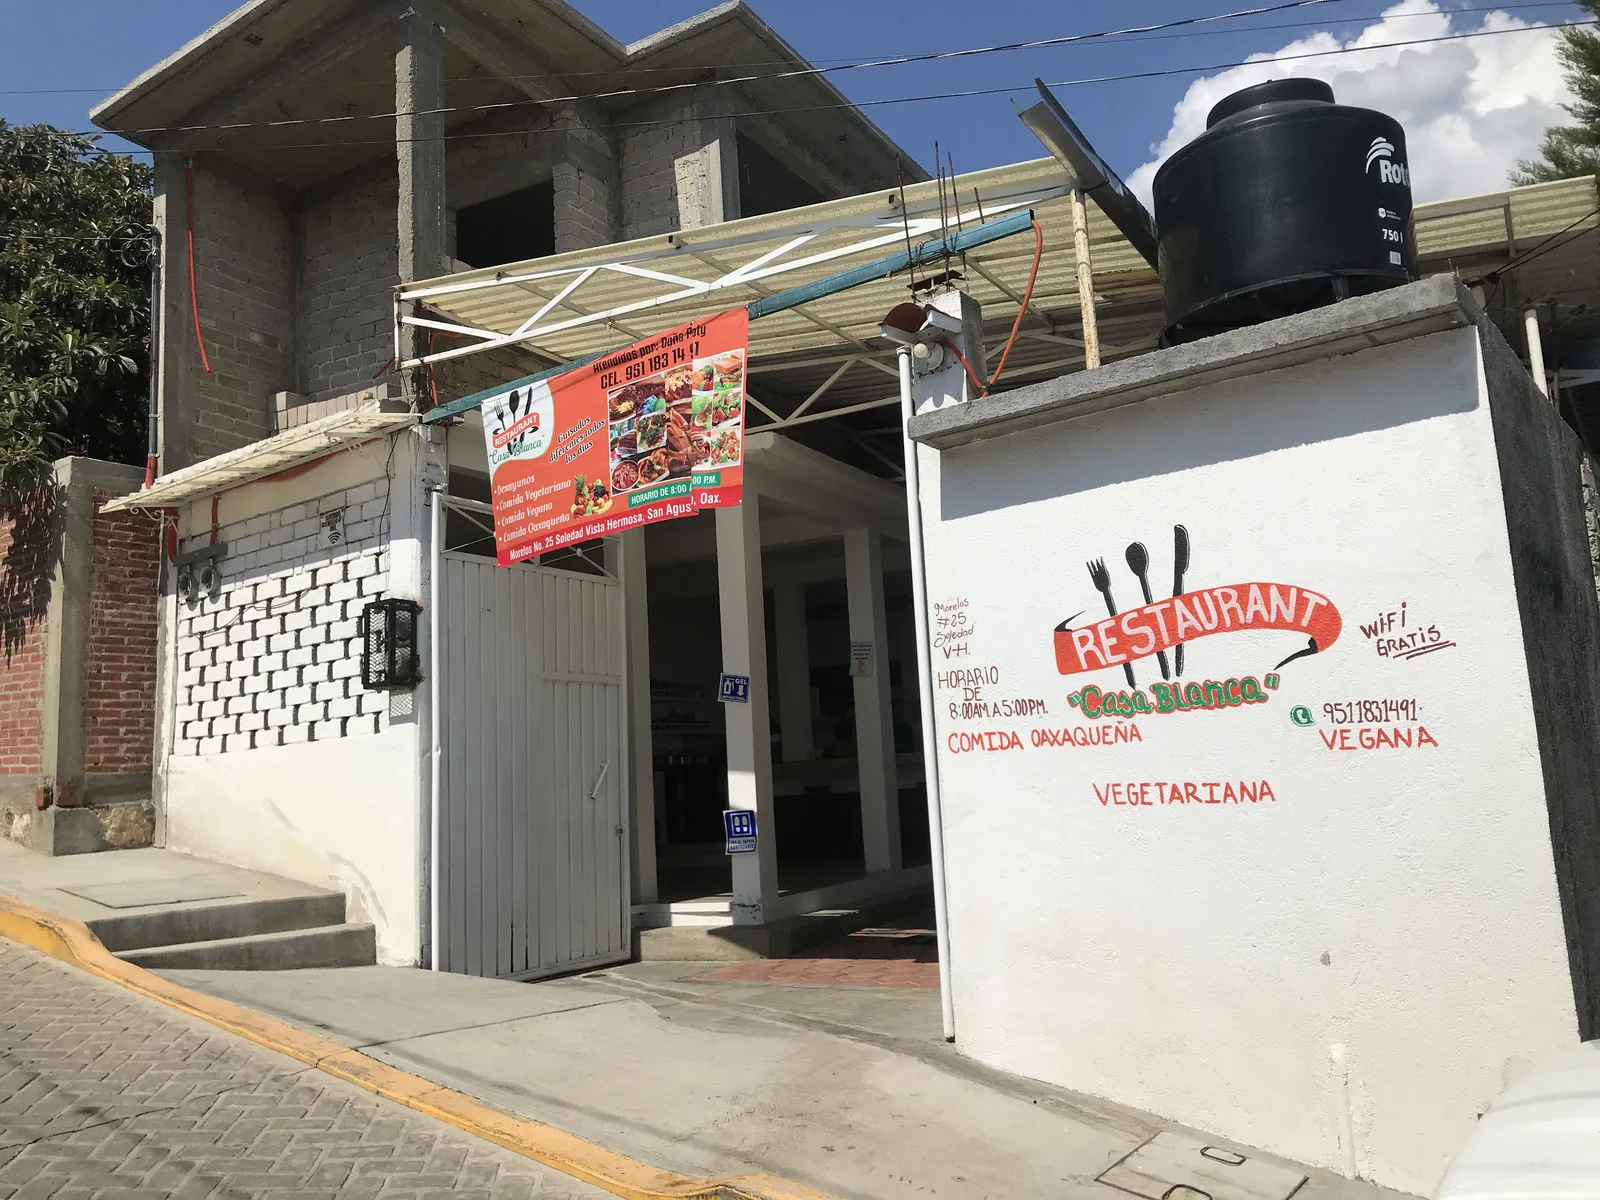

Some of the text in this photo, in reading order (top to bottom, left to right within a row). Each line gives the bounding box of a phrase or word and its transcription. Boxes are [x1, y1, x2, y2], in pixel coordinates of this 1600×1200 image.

[1382, 228, 1399, 242] 750
[639, 342, 659, 358] por:
[661, 332, 684, 348] Doña
[686, 324, 706, 339] Paty
[600, 371, 622, 389] CEL.
[625, 359, 646, 381] 951
[647, 351, 669, 374] 183
[672, 347, 686, 364] 14
[494, 415, 538, 447] RESTAURANT
[548, 419, 605, 463] diferentes todos
[557, 416, 591, 444] Guisados
[565, 453, 577, 464] los
[703, 475, 718, 485] P.M.
[499, 480, 571, 511] Comida Vegetariana
[631, 489, 659, 505] HORARIO
[660, 486, 669, 497] DE
[670, 484, 687, 495] 8:00
[700, 492, 722, 505] Oax.
[501, 502, 553, 527] Comida Vegana
[503, 513, 570, 542] Comida Oaxaqueña
[509, 546, 532, 560] Morelos
[533, 541, 544, 552] No.
[545, 536, 554, 548] 25
[555, 527, 584, 545] Soledad
[585, 521, 605, 536] Vista
[607, 511, 645, 531] Hermosa,
[647, 507, 664, 520] San
[934, 598, 969, 616] Morelos
[937, 612, 967, 628] #25
[1071, 583, 1327, 670] RESTAURANT
[934, 625, 974, 647] Soledad
[963, 687, 983, 702] DE
[948, 721, 1143, 754] COMIDA OAXAQUEÑA
[1319, 725, 1439, 750] VEGANA
[1092, 780, 1276, 806] VEGETARIANA
